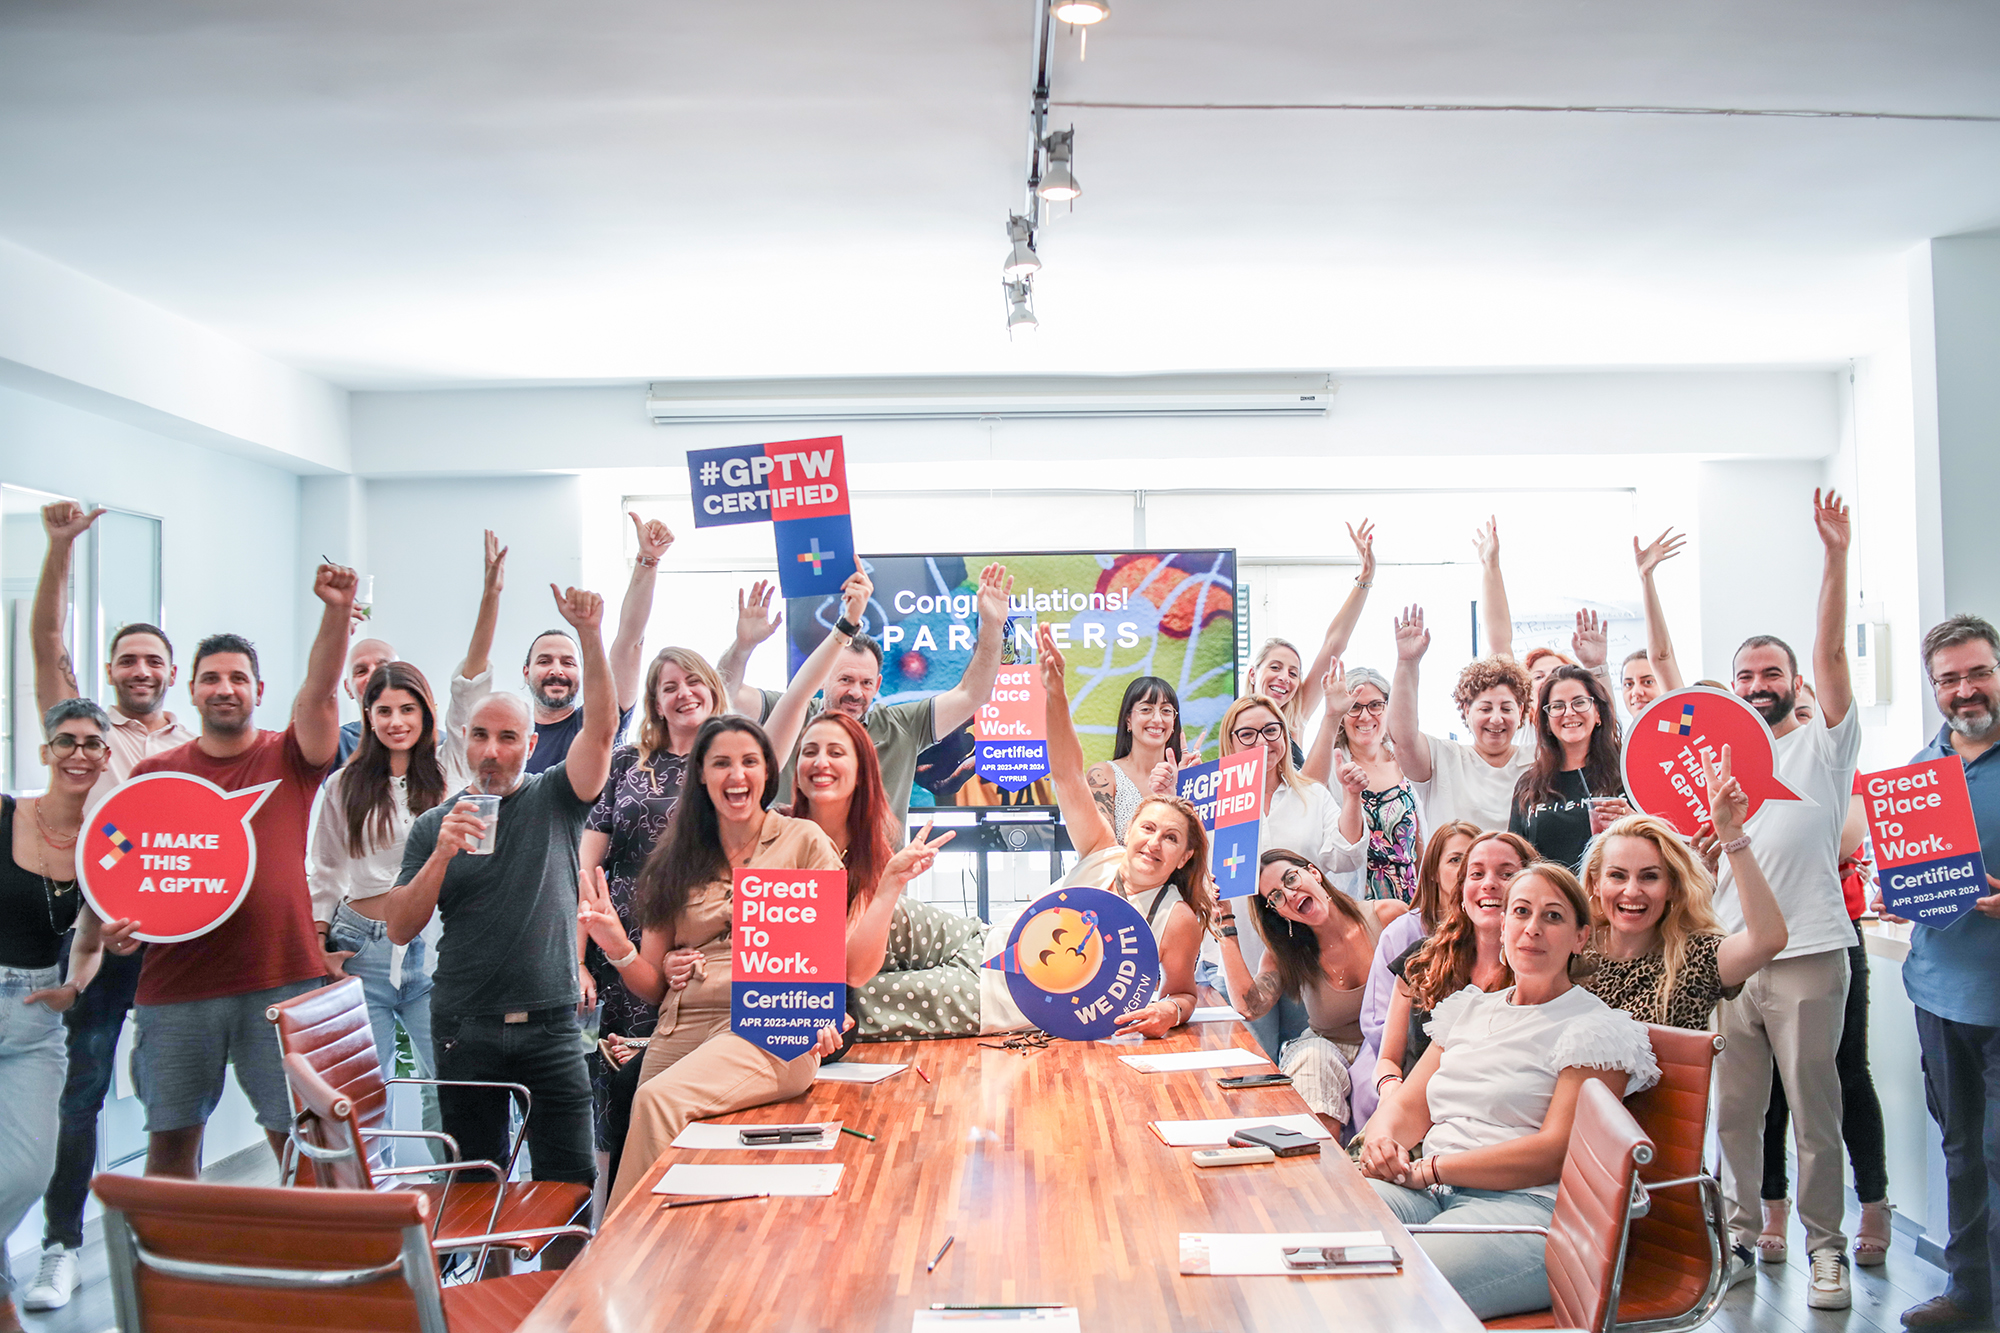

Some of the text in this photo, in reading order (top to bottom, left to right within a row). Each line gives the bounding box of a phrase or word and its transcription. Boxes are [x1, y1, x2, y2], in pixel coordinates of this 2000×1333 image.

[700, 449, 834, 487] #GPTW
[703, 484, 839, 515] CERTIFIED
[894, 587, 1128, 619] Congrulations!
[883, 621, 1139, 651] PARNERS
[994, 671, 1031, 685] reat
[991, 687, 1030, 702] lace
[980, 704, 1000, 718] To
[1692, 734, 1706, 746] I
[982, 745, 1043, 759] Certified
[1658, 760, 1675, 776] A
[1677, 745, 1707, 788] THIS
[1181, 759, 1258, 800] #GPTW
[1868, 768, 1939, 797] Great
[1194, 791, 1256, 821] ERTIFIED
[1872, 793, 1942, 818] Place
[141, 832, 220, 850] I MAKE
[1875, 820, 1904, 839] To
[139, 854, 191, 871] THIS
[138, 876, 229, 894] A GPTW.
[740, 875, 818, 899] Great
[1890, 861, 1975, 890] Certified
[1892, 896, 1913, 908] APR
[1958, 884, 1981, 896] 2024
[742, 900, 817, 924] Place
[1919, 904, 1959, 918] CYPRUS
[739, 926, 770, 948] To
[1073, 925, 1139, 1025] WE DID IT!
[742, 990, 834, 1010] Certified
[1122, 973, 1151, 1014] #GPTW
[739, 1017, 762, 1027] APR
[813, 1018, 836, 1028] 2024
[766, 1035, 810, 1045] CYPRUS
